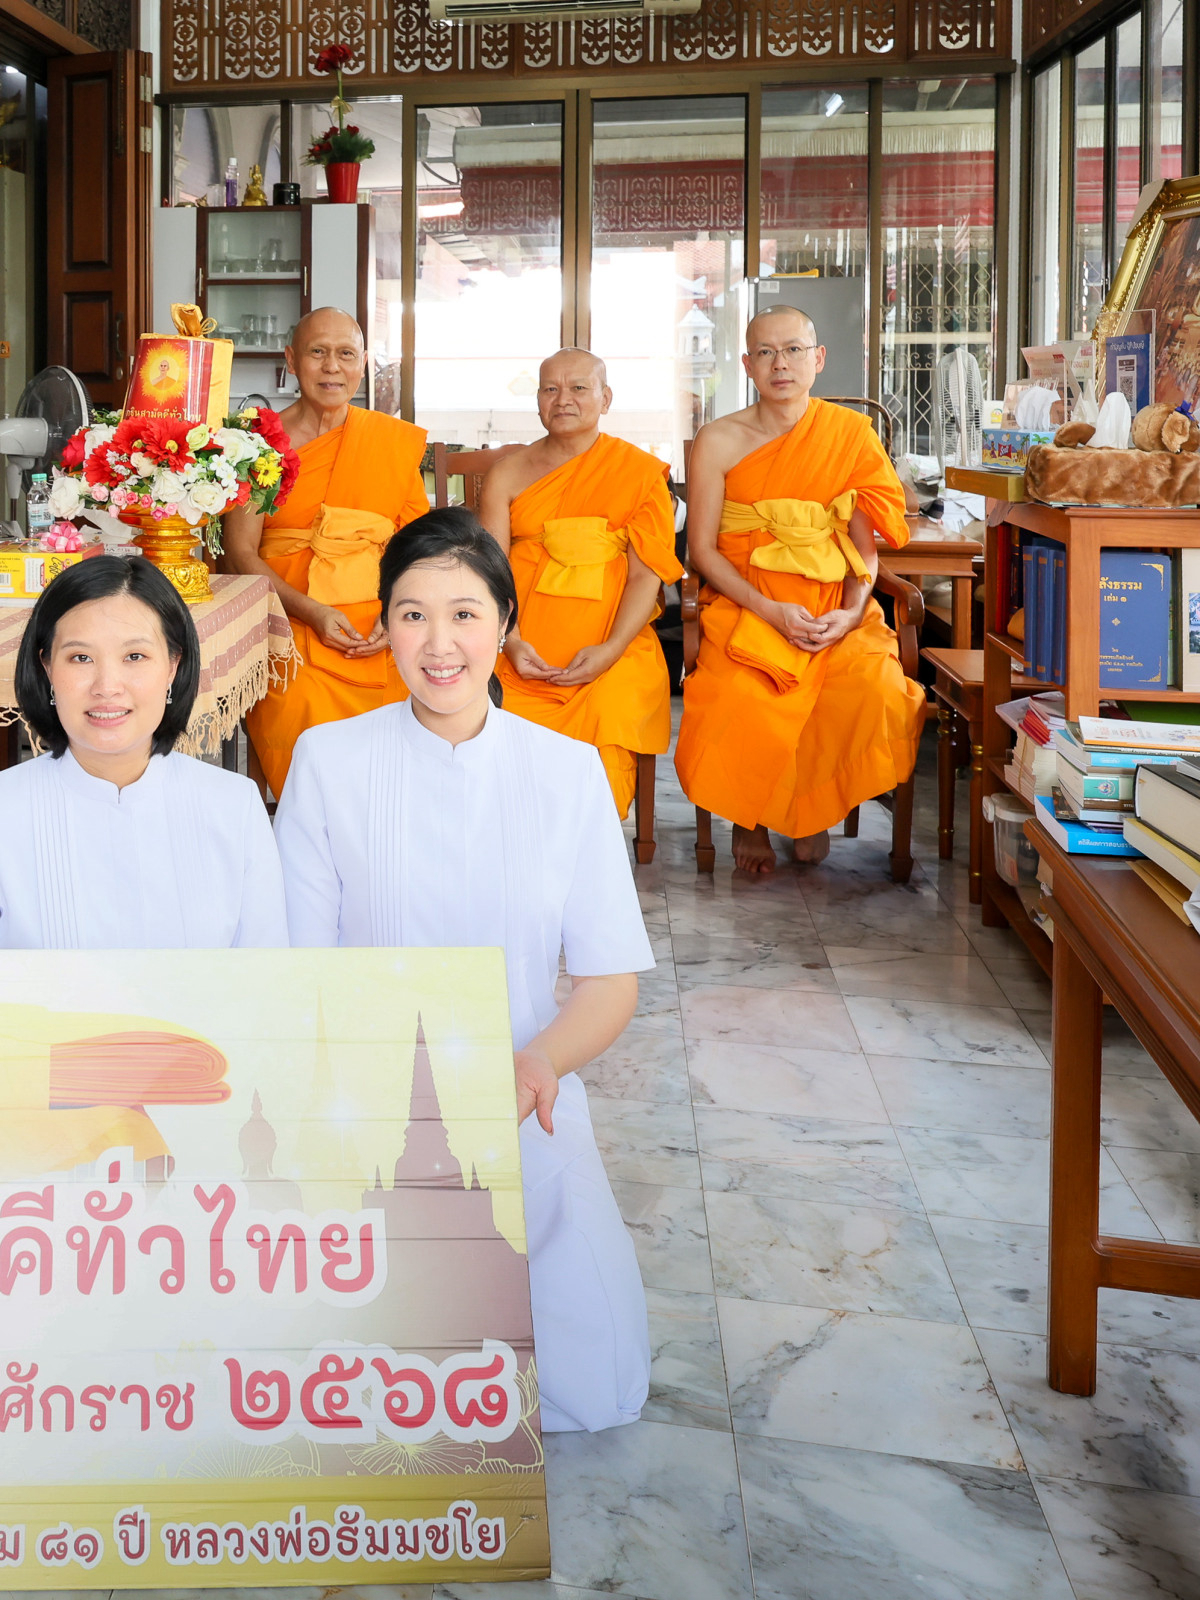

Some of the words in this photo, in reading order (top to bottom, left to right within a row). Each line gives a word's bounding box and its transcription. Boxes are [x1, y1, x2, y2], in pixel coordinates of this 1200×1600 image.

[1098, 576, 1143, 591] ลังธรรม
[222, 1353, 509, 1431] ๒๕๖๘
[40, 1528, 99, 1563] ๘๑
[118, 1511, 145, 1560] ปี
[165, 1506, 500, 1559] หลวงพ่อธัมมชโย
